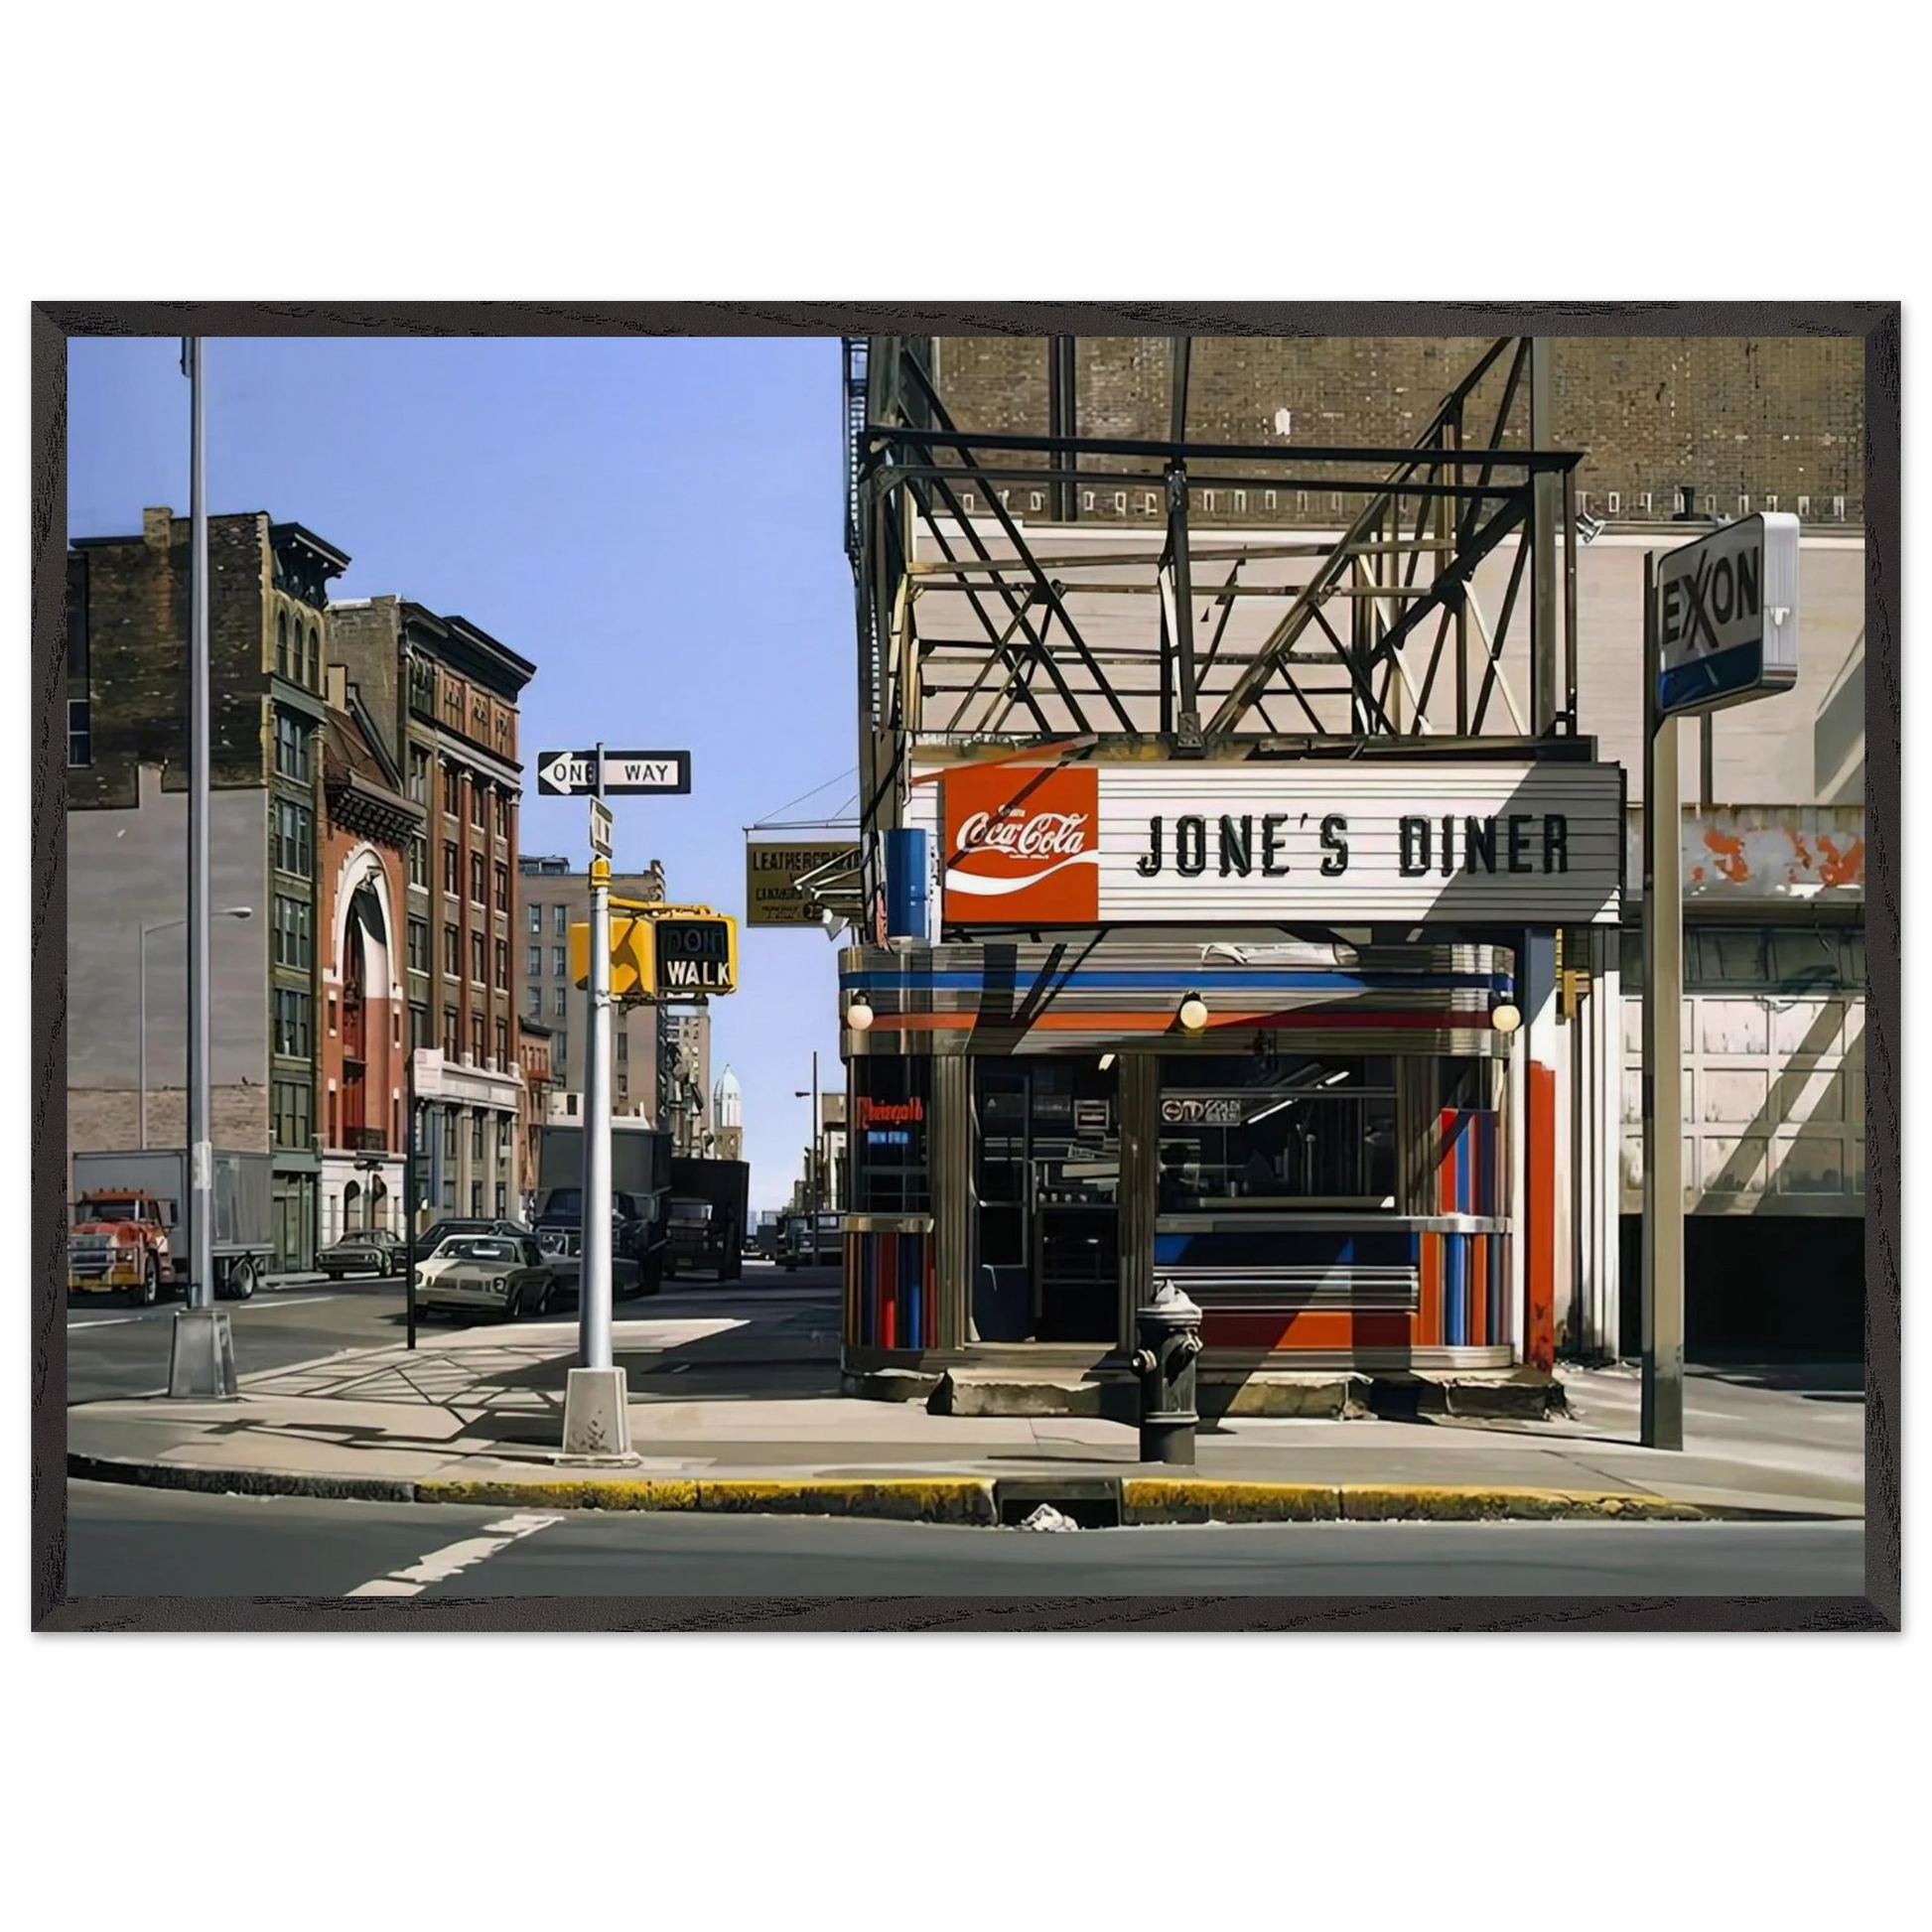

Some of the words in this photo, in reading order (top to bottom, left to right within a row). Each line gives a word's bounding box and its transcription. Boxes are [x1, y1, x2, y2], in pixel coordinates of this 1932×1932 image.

[1662, 546, 1759, 650] EXXON
[624, 764, 668, 781] WAY
[956, 811, 1088, 855] Coca-Cola
[1136, 813, 1349, 878] JONE'S
[1399, 814, 1569, 878] DINER
[667, 960, 730, 986] WALK
